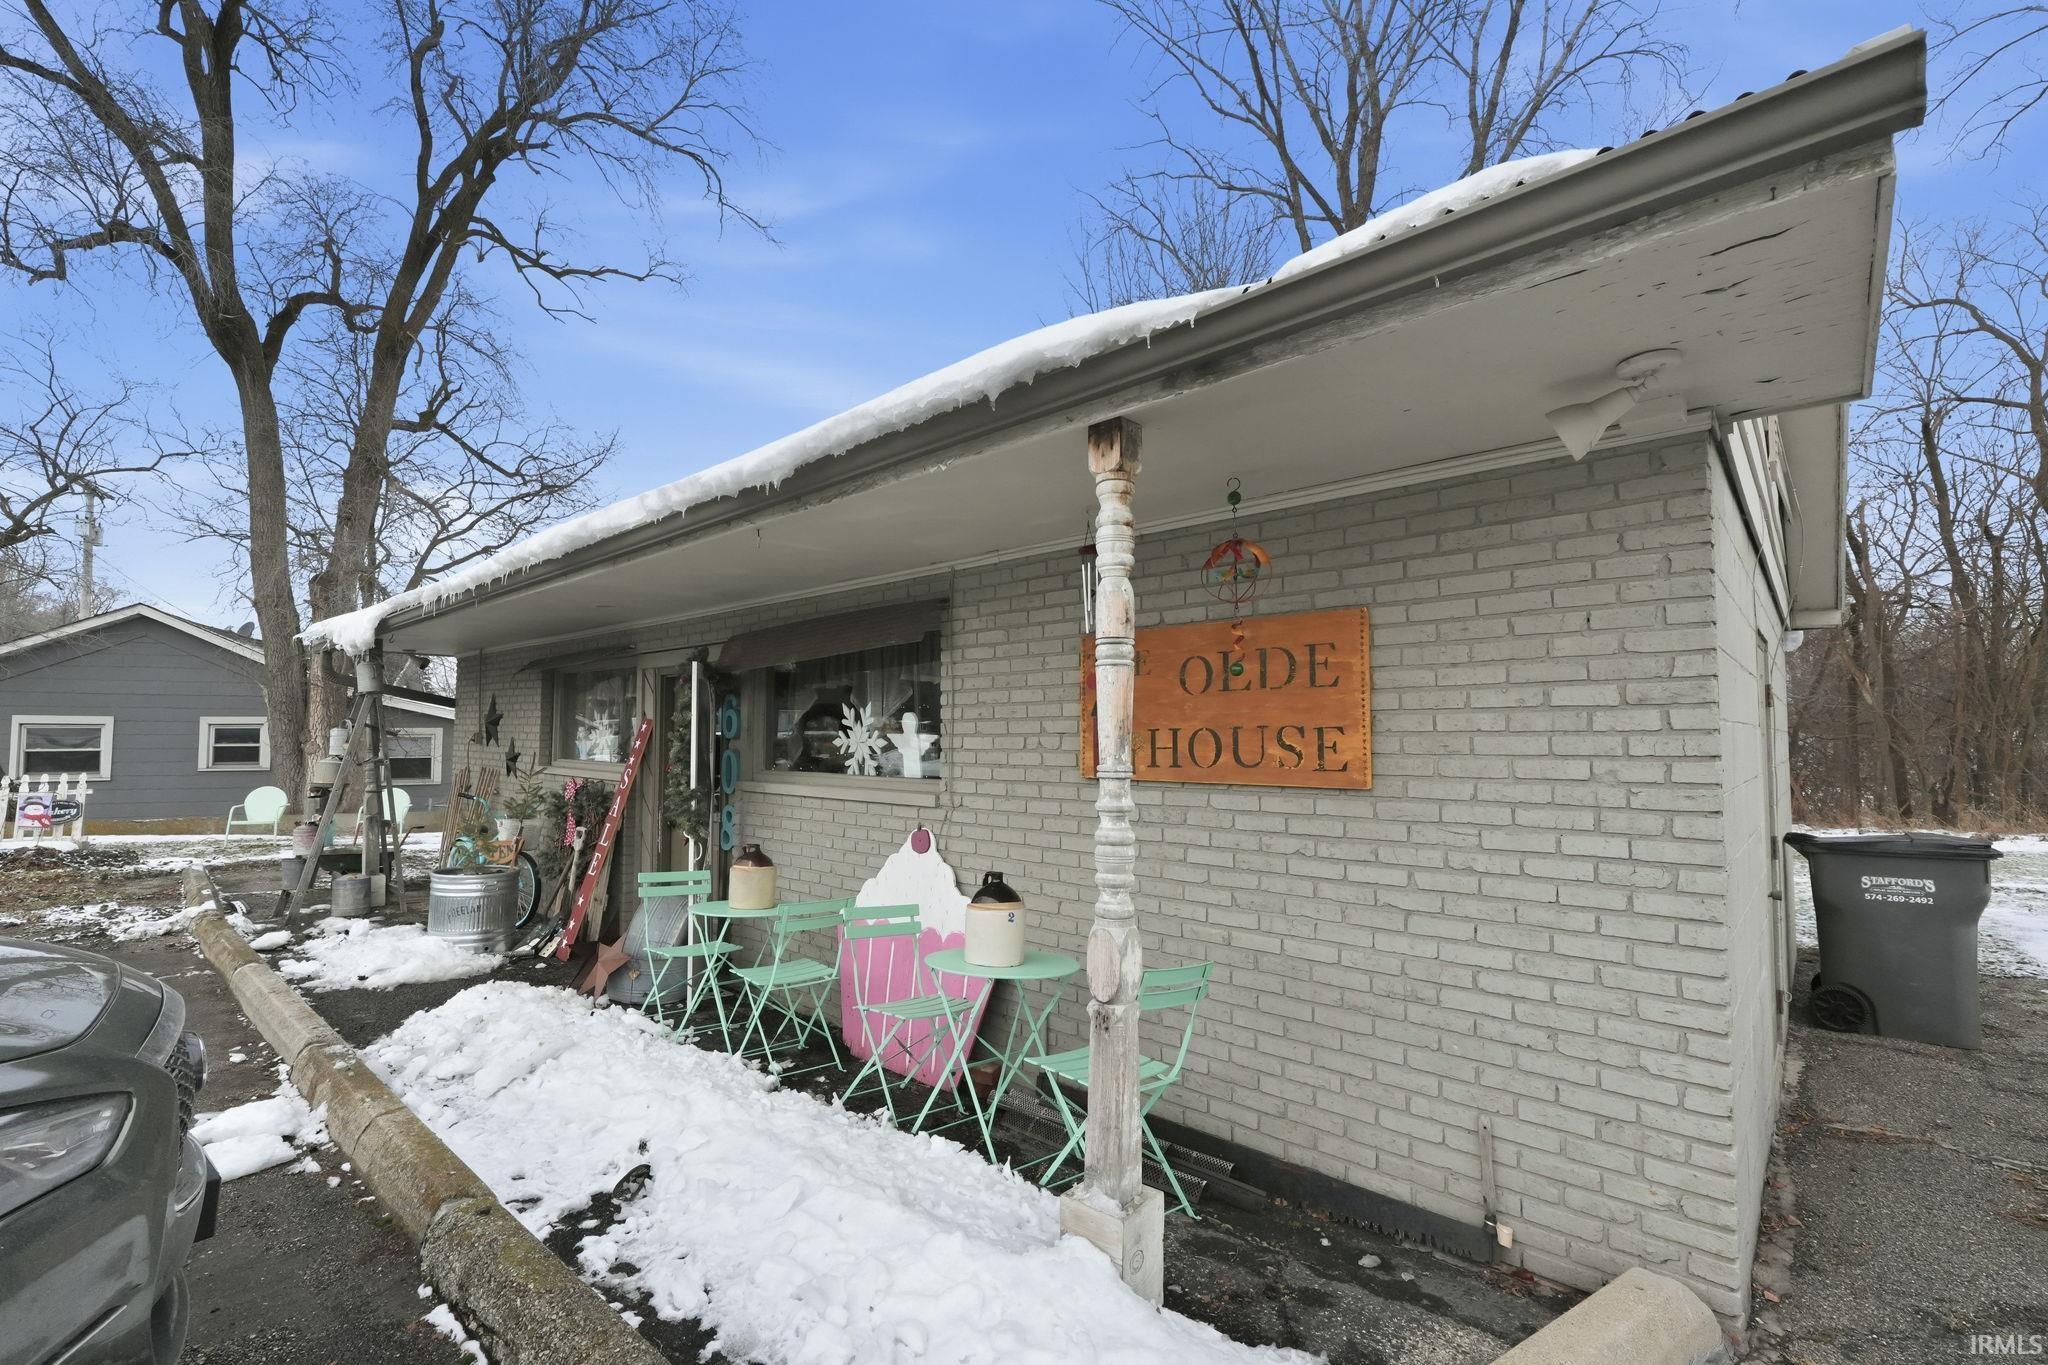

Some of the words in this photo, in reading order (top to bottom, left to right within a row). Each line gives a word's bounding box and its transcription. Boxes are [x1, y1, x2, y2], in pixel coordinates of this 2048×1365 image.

[1179, 642, 1340, 696] OLDE
[720, 693, 738, 851] 608
[1147, 725, 1349, 773] HOUSE
[586, 767, 632, 876] SALE
[1861, 875, 1936, 893] STAFFORD'S
[1864, 893, 1934, 905] 574-269-2492
[1007, 911, 1015, 923] 2
